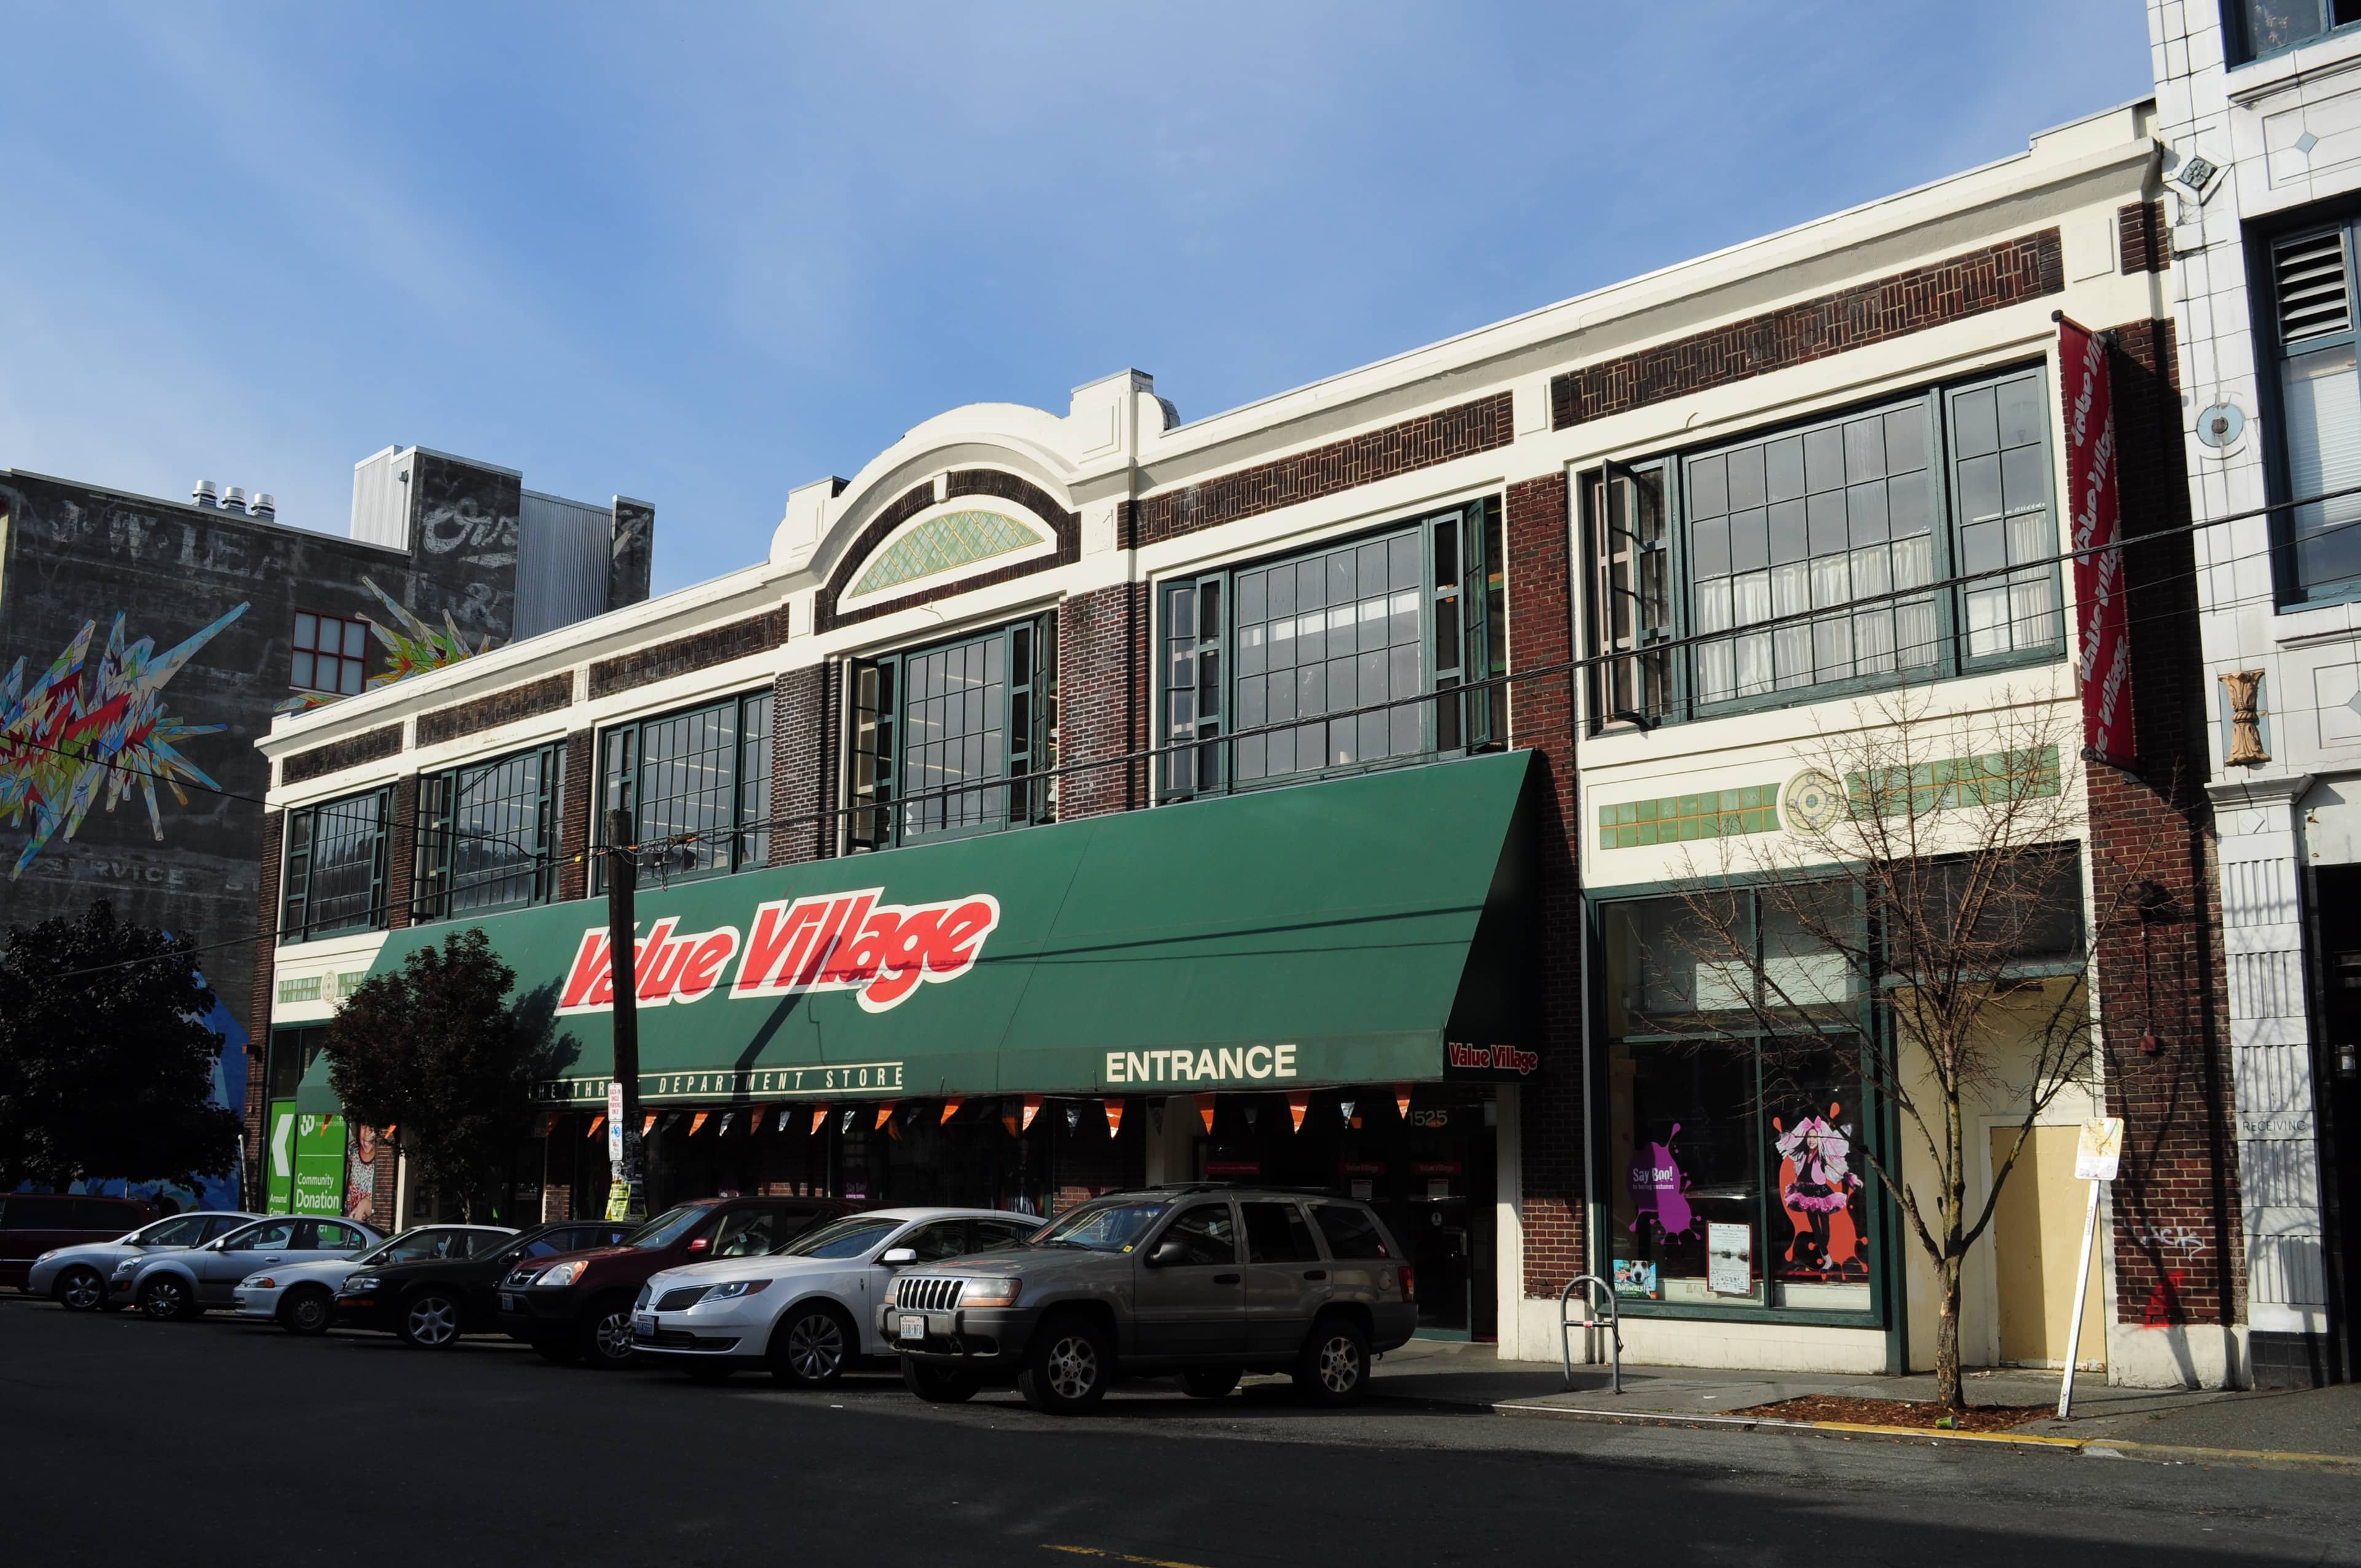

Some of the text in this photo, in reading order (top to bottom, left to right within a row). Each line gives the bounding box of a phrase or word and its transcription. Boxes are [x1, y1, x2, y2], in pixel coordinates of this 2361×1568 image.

[2097, 635, 2128, 728] Village
[558, 893, 995, 1010] Value Village
[1106, 1044, 1297, 1082] ENTRANCE
[1449, 1042, 1538, 1075] Value Village
[659, 1072, 804, 1094] DEPARTMENT
[826, 1067, 904, 1088] STORE
[1408, 1110, 1448, 1127] 1525
[2242, 1120, 2306, 1131] RECEIVING
[298, 1173, 334, 1189] Community
[1633, 1166, 1673, 1184] Say Boo!
[269, 1194, 287, 1203] Around
[296, 1189, 339, 1210] Donation
